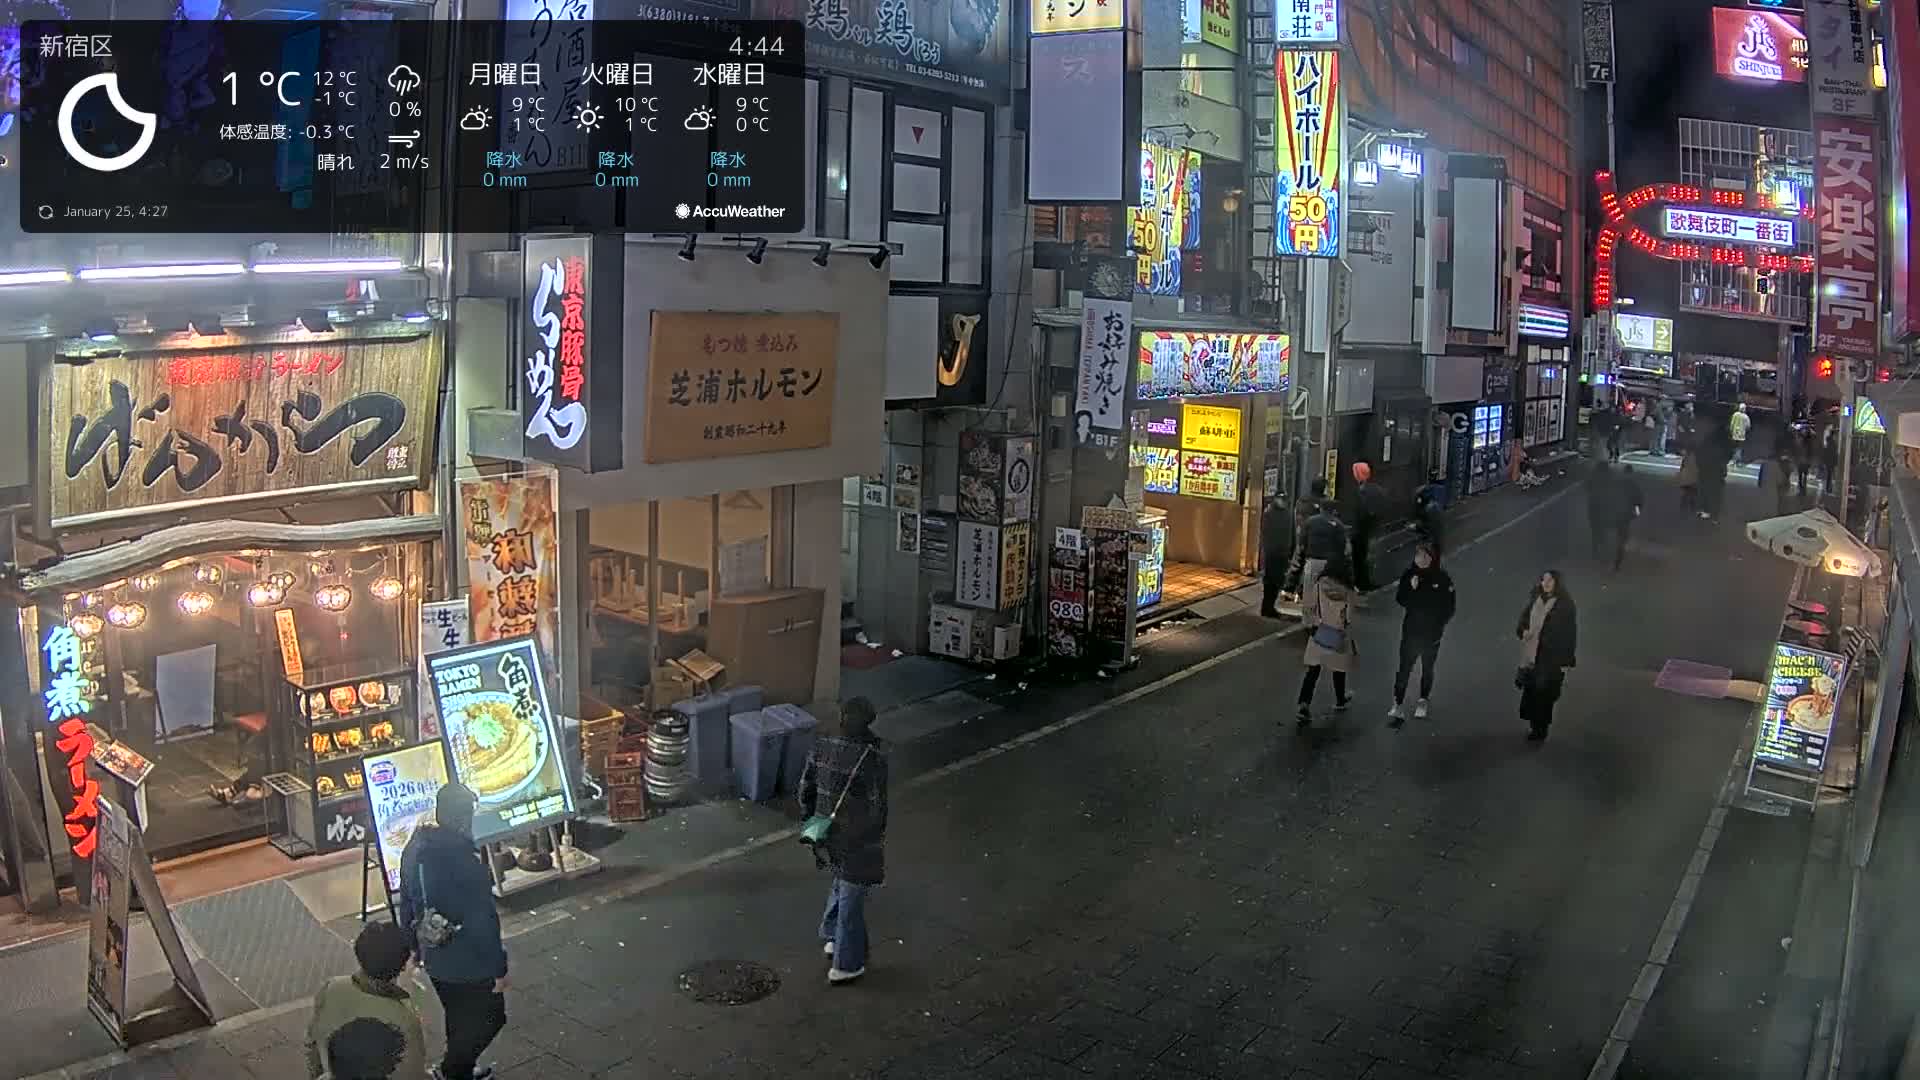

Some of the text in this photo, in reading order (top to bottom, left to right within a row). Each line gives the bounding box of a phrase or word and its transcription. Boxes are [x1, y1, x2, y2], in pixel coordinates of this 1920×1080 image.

[1589, 64, 1609, 79] 7F
[1295, 54, 1322, 190] ハイボール
[1159, 150, 1175, 288] ハイボール
[1669, 211, 1790, 243] 歌舞伎町一番街
[1817, 128, 1876, 330] 安楽亭
[561, 256, 585, 400] 東京豚骨
[669, 366, 824, 406] 芝浦ホルモン
[434, 663, 480, 684] TOKYO
[499, 653, 541, 721] 角煮
